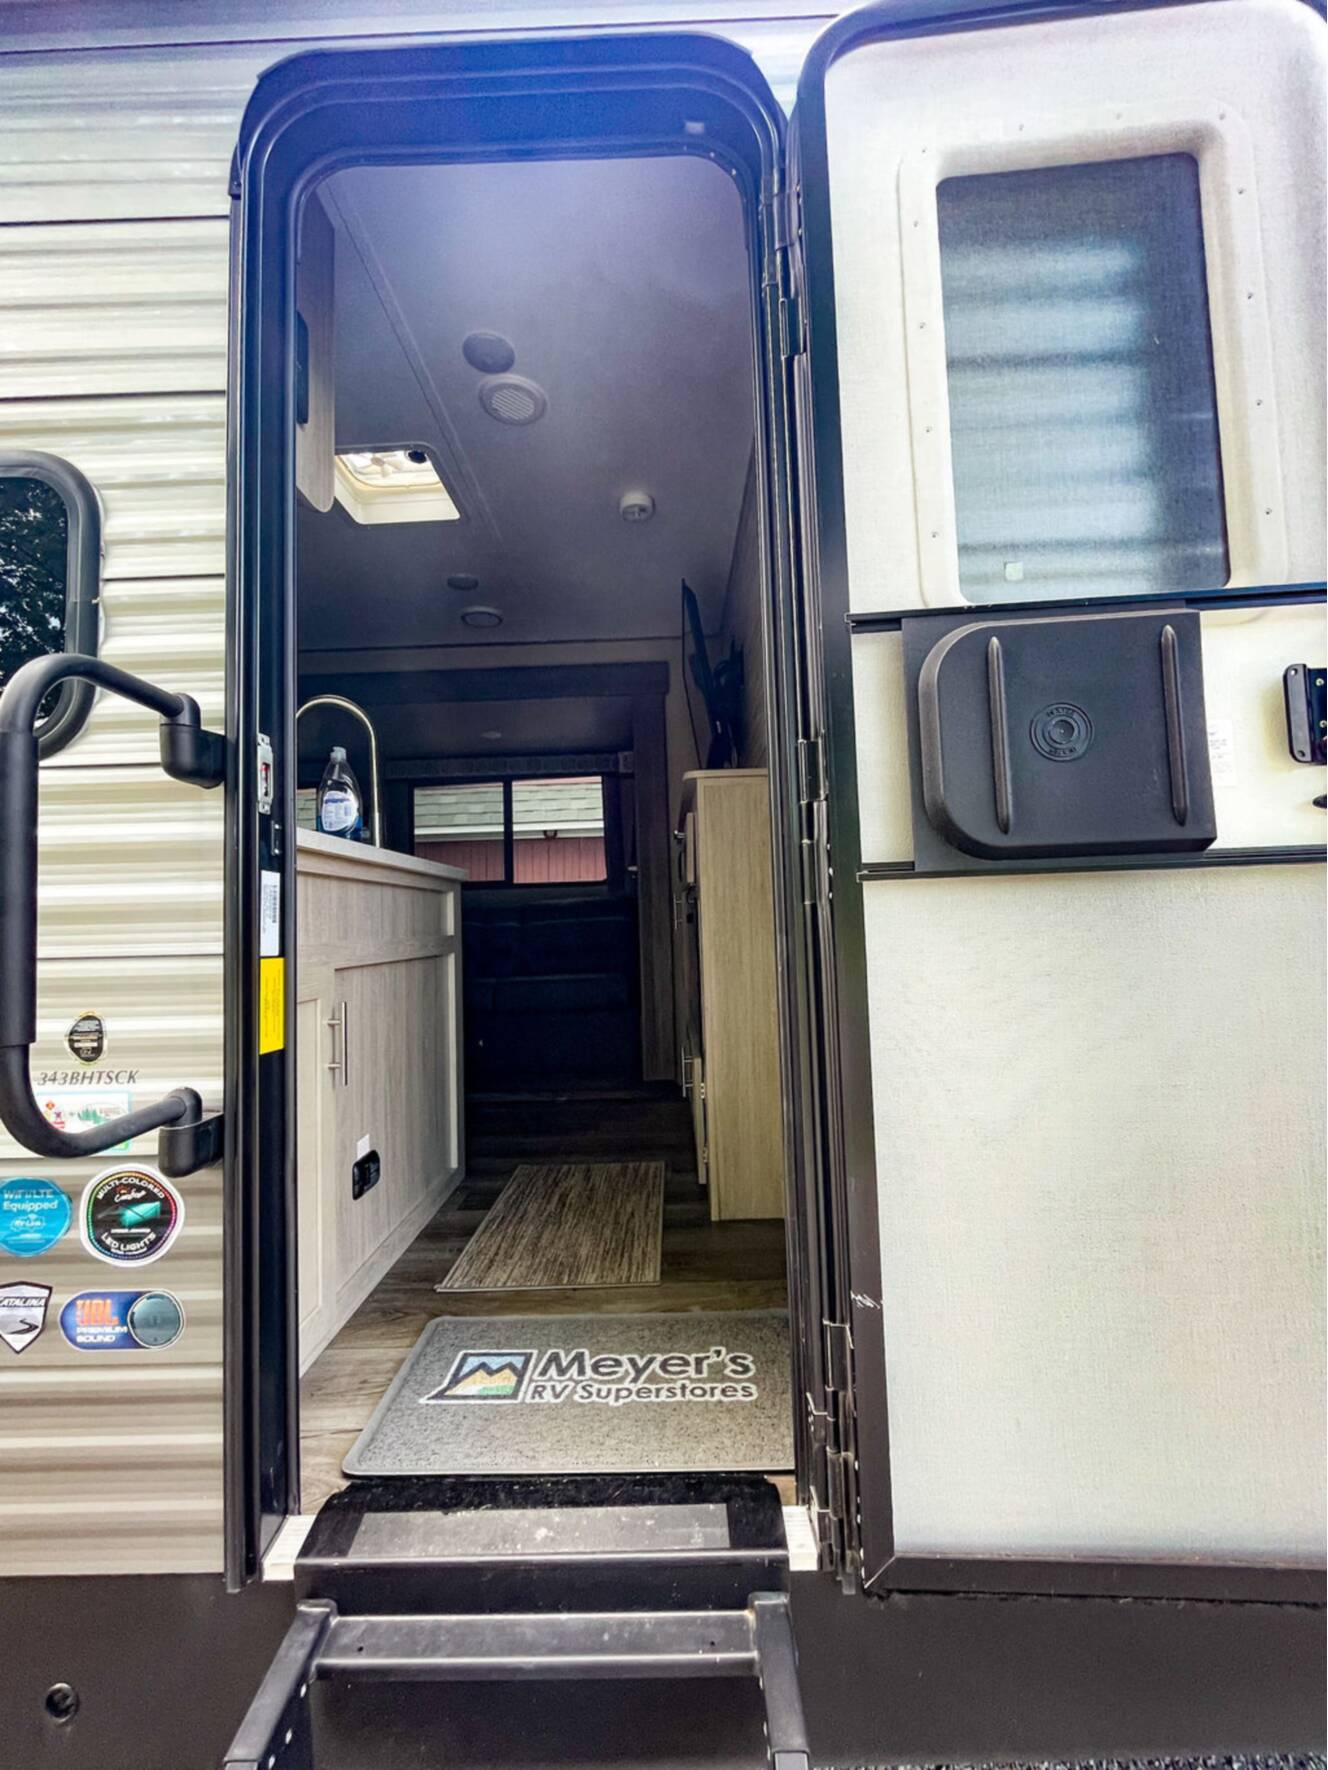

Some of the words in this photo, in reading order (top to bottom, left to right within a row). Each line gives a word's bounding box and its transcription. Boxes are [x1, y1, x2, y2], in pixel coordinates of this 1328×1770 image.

[37, 1070, 139, 1086] 343BHTSCK
[97, 1177, 165, 1200] MULTI-COLORED
[3, 1200, 58, 1213] Equipped
[101, 1232, 119, 1248] LED
[120, 1232, 157, 1251] LIGHTS
[537, 1347, 756, 1384] Meyer's
[529, 1384, 575, 1402] RV
[578, 1383, 756, 1406] Superstores
